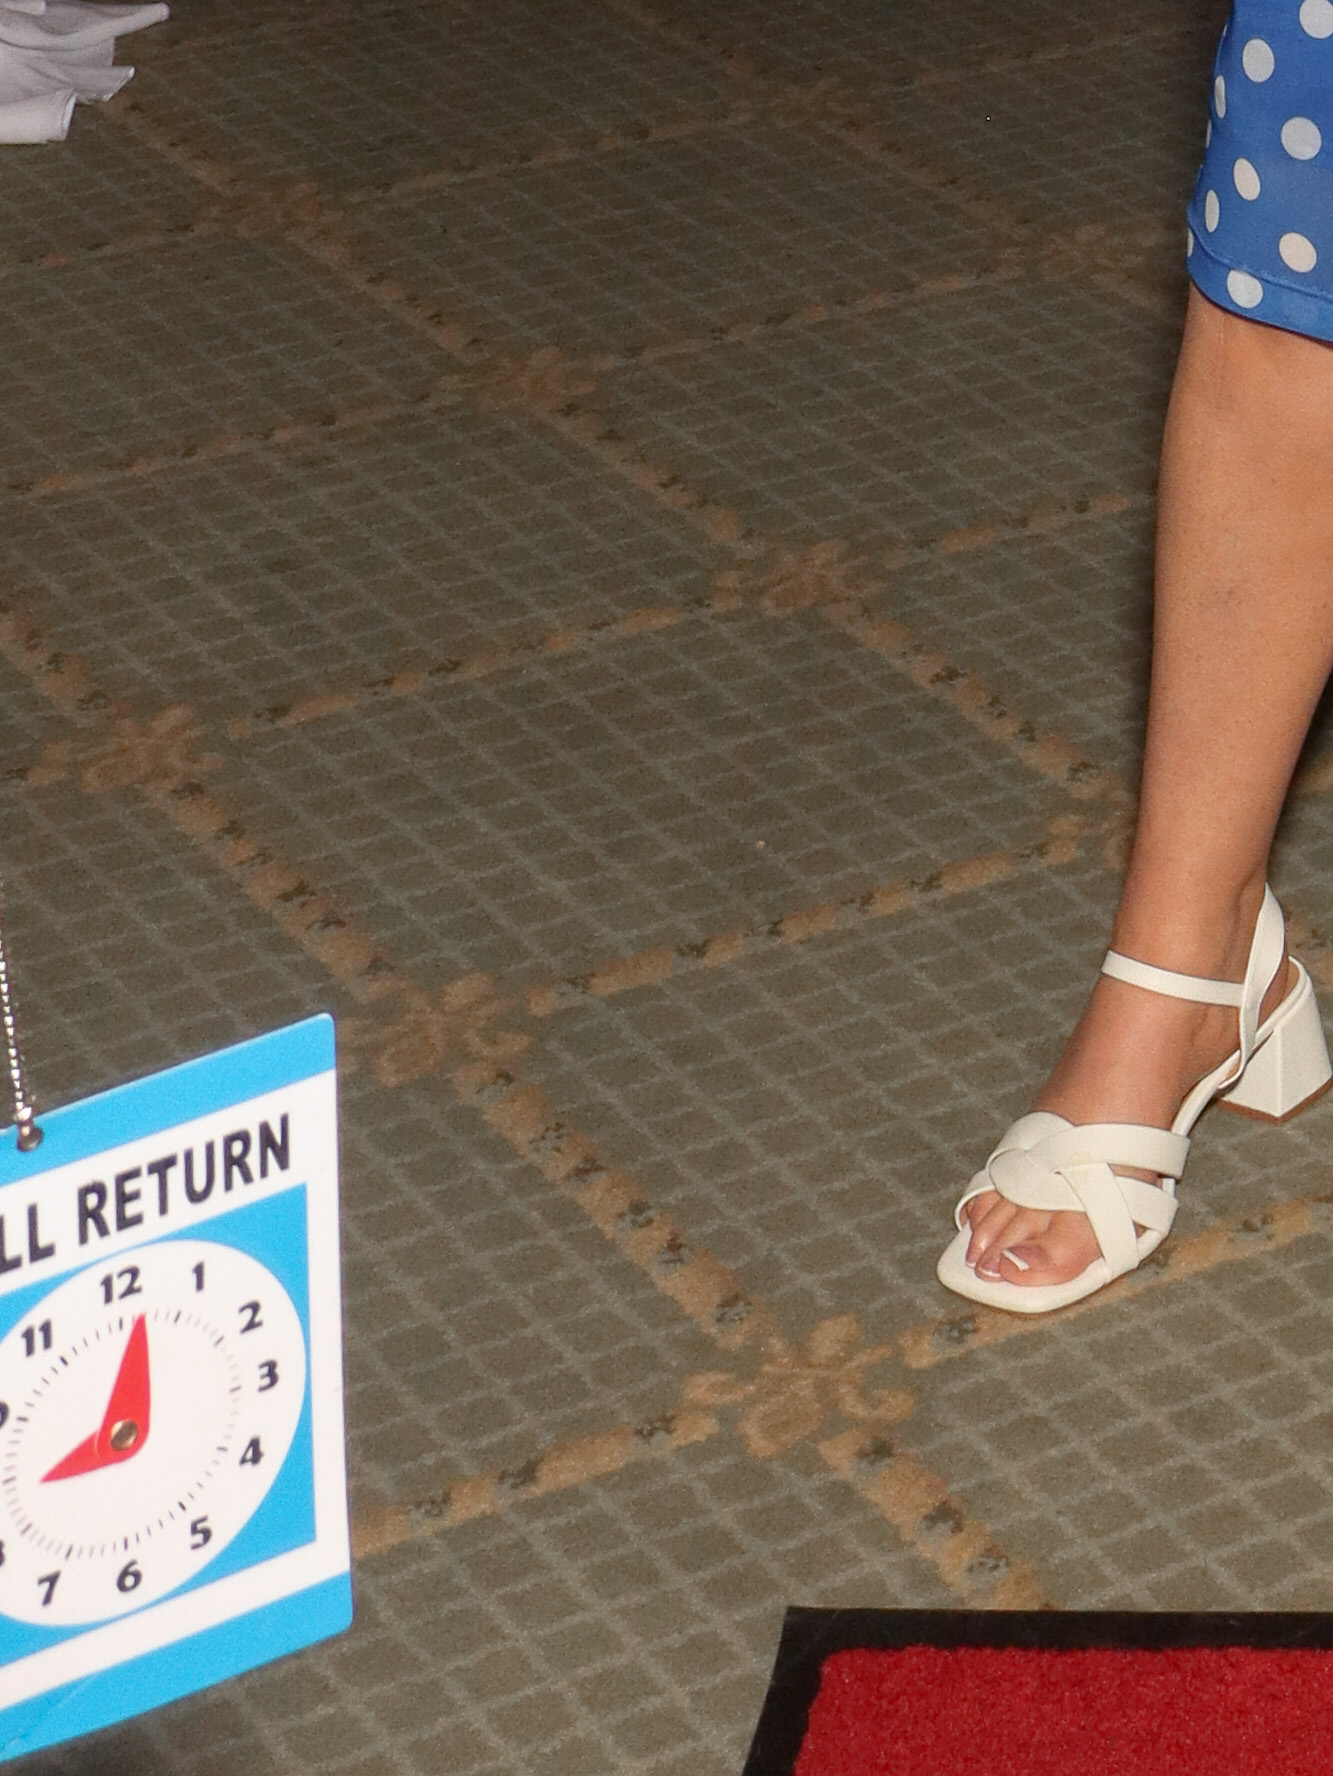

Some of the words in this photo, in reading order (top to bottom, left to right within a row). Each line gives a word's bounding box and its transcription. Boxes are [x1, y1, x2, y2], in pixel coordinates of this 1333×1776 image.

[77, 1112, 291, 1247] RETURN
[100, 1264, 143, 1305] 12
[192, 1261, 206, 1292] 1
[238, 1300, 264, 1335] 2
[20, 1318, 53, 1359] 11
[257, 1359, 280, 1393] 3
[239, 1436, 264, 1467] 4
[189, 1514, 214, 1550] 5
[37, 1569, 62, 1607] 7
[115, 1559, 143, 1595] 6
